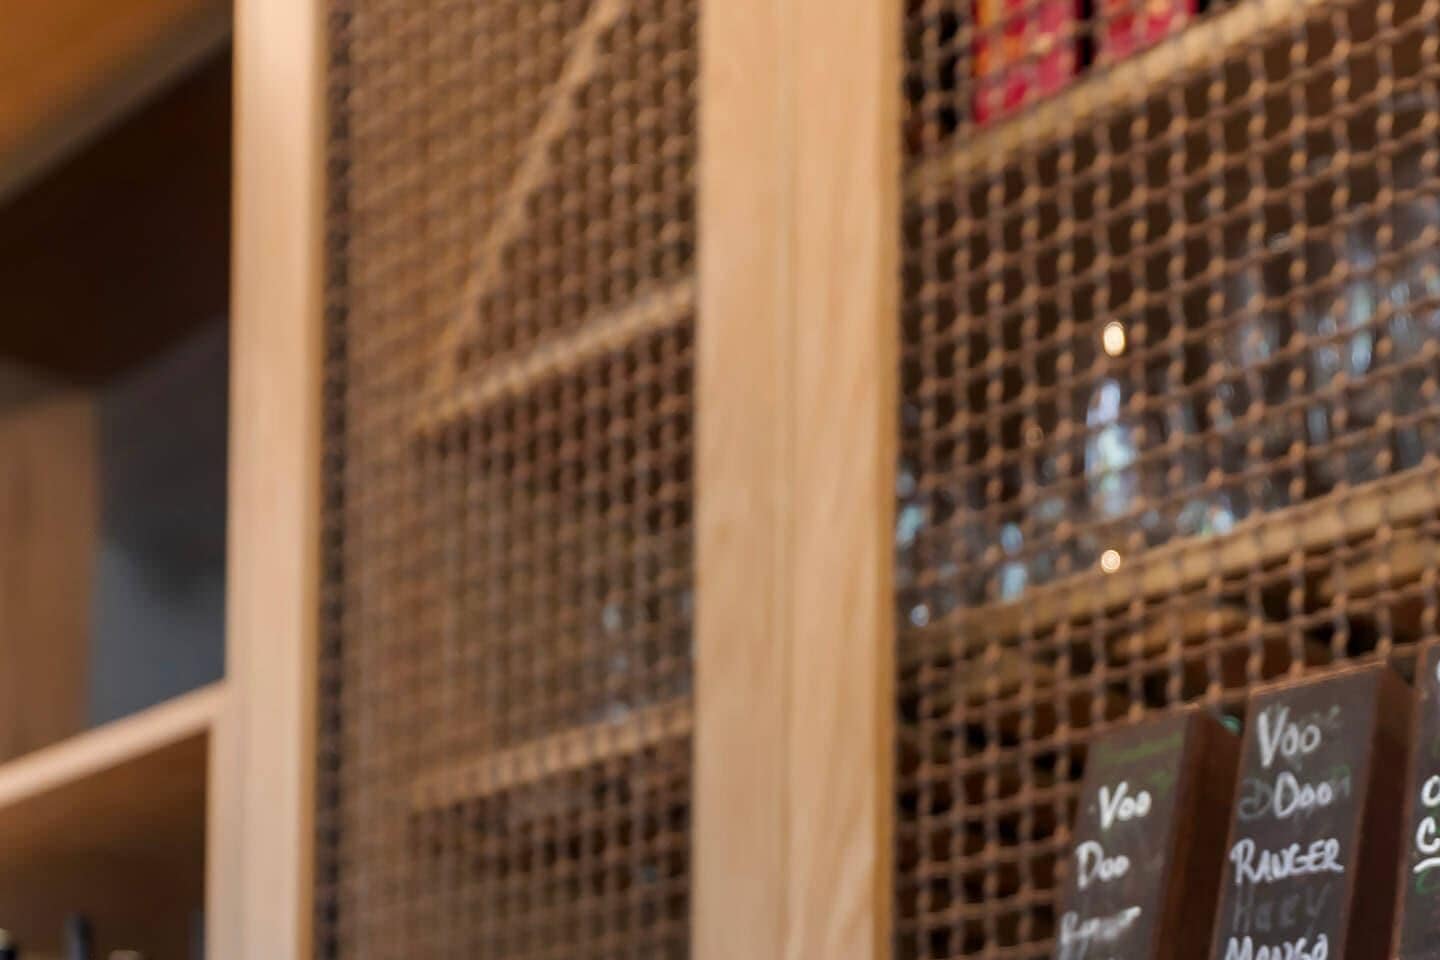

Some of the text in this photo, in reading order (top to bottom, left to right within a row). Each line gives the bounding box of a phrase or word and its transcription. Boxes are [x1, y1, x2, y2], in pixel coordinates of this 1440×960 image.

[1256, 706, 1322, 769] Voo
[1098, 780, 1152, 830] Voo
[1075, 839, 1131, 890] Doo
